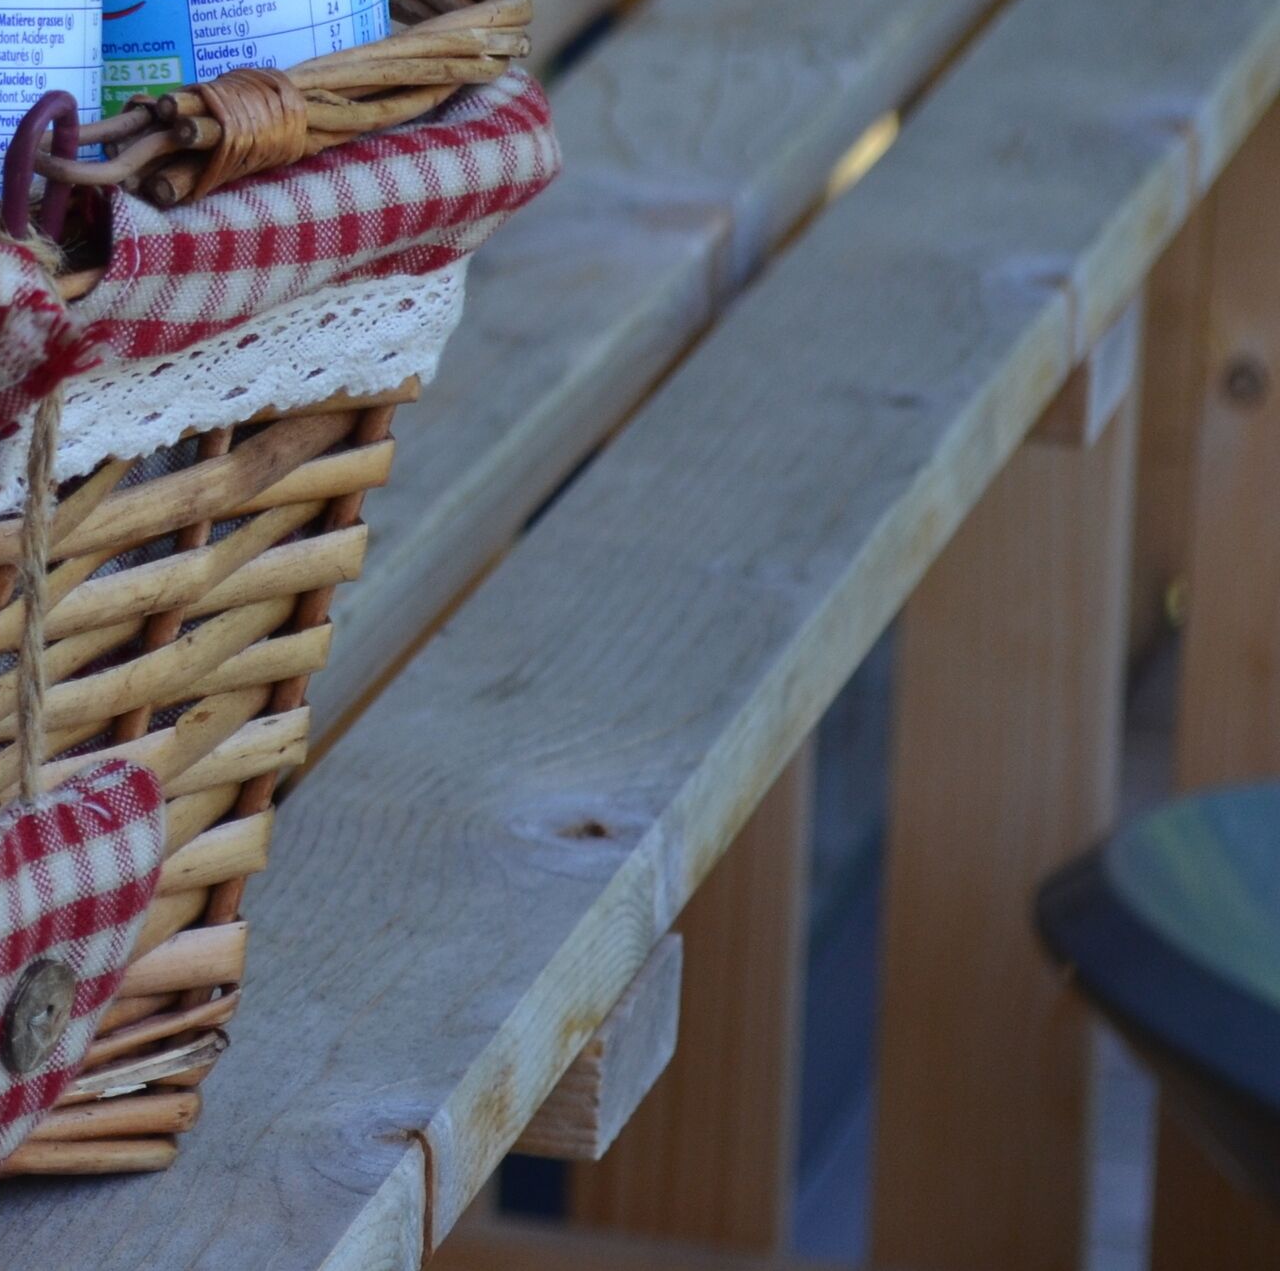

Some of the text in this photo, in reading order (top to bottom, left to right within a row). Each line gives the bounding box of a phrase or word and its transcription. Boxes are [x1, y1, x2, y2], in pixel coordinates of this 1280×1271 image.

[192, 1, 277, 23] dont Acides gras
[37, 15, 64, 30] grasses
[65, 13, 75, 30] (g)
[194, 20, 250, 40] saturés (g)
[21, 31, 48, 44] Acides
[49, 33, 65, 48] gras
[31, 48, 44, 66] (g)
[196, 41, 258, 61] Glucides (g)
[137, 62, 172, 80] 125
[198, 63, 223, 78] dont
[35, 72, 47, 89] (g)
